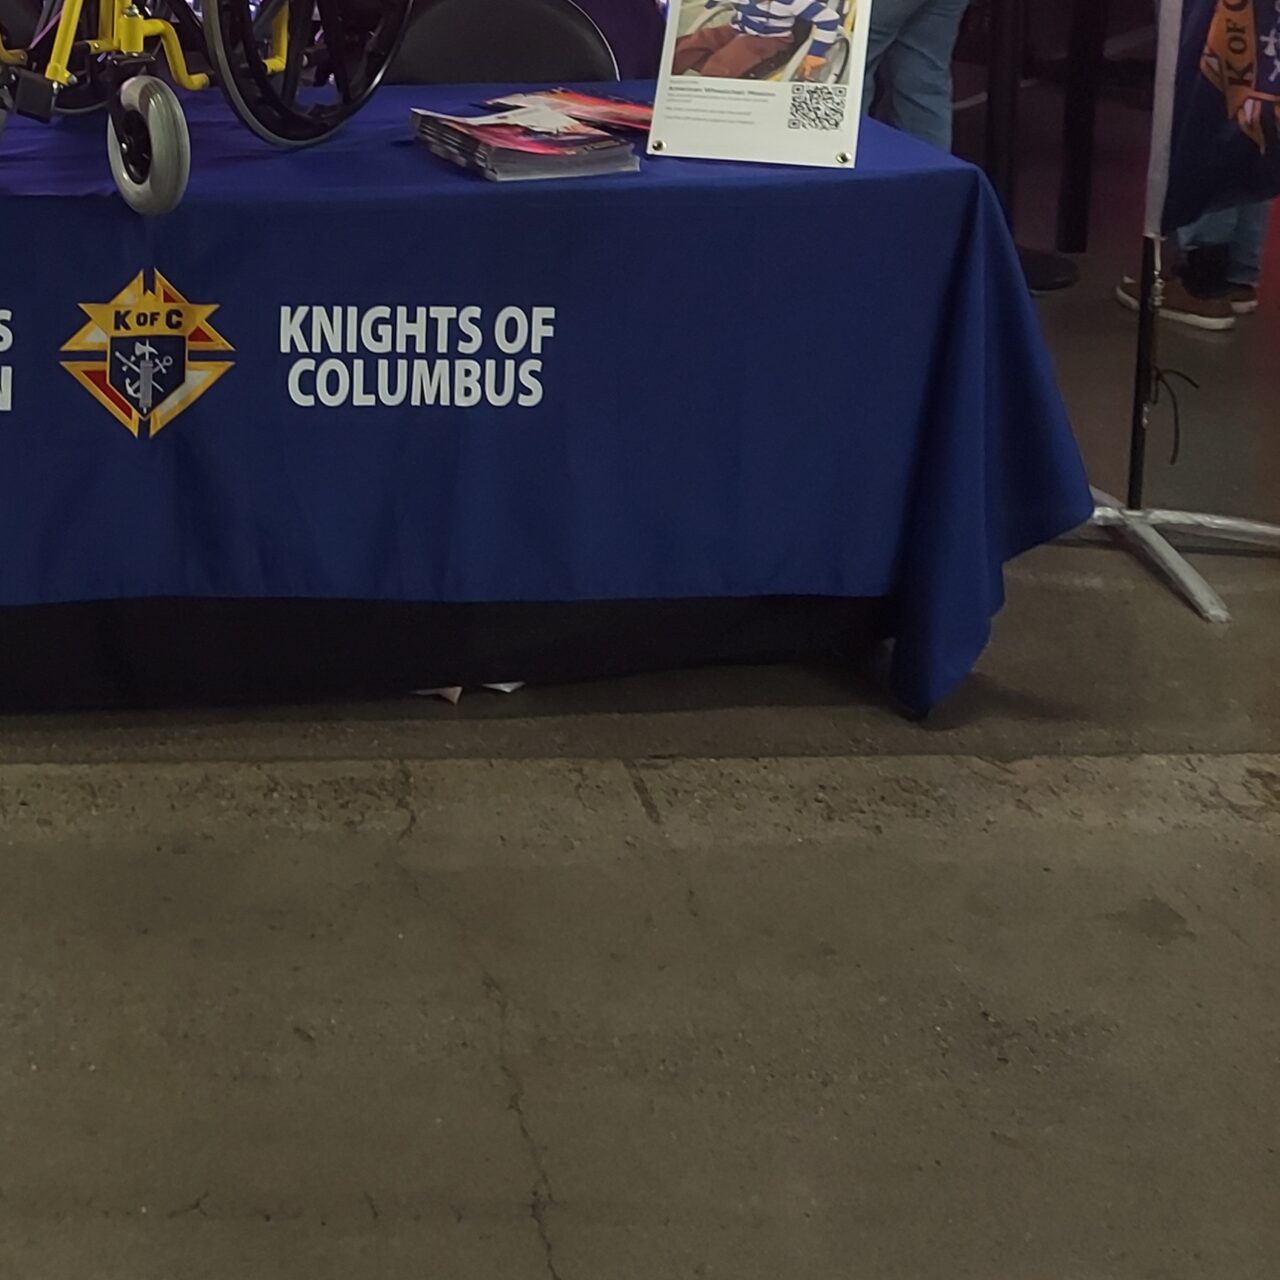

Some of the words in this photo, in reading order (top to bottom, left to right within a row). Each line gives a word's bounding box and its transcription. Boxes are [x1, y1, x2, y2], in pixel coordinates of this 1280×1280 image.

[1226, 61, 1254, 87] K
[114, 310, 132, 331] K
[136, 312, 160, 327] OF
[166, 308, 183, 329] C
[280, 305, 483, 354] KNIGHTS
[494, 305, 556, 354] OF
[287, 358, 543, 407] COLUMBUS
